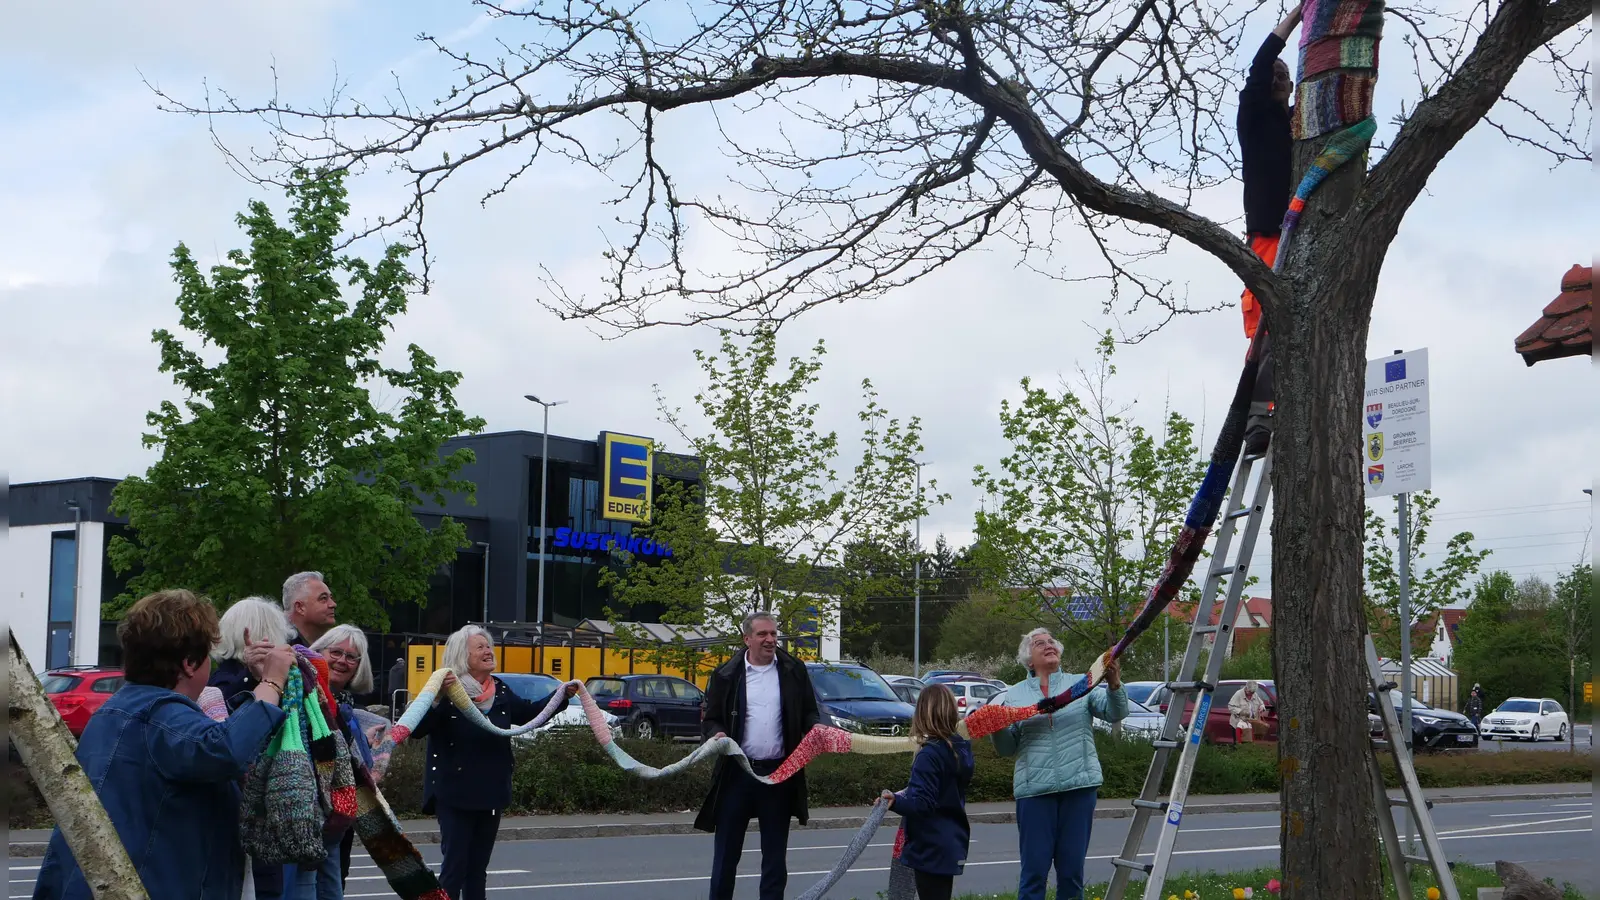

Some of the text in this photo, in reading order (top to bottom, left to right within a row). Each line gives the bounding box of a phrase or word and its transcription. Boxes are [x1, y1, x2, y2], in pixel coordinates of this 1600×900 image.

[1366, 379, 1425, 397] WIR SIND PARTNER
[609, 441, 647, 500] E
[1397, 462, 1414, 470] LARCHE
[608, 502, 647, 515] EDEKA
[1196, 701, 1208, 728] ZARGES
